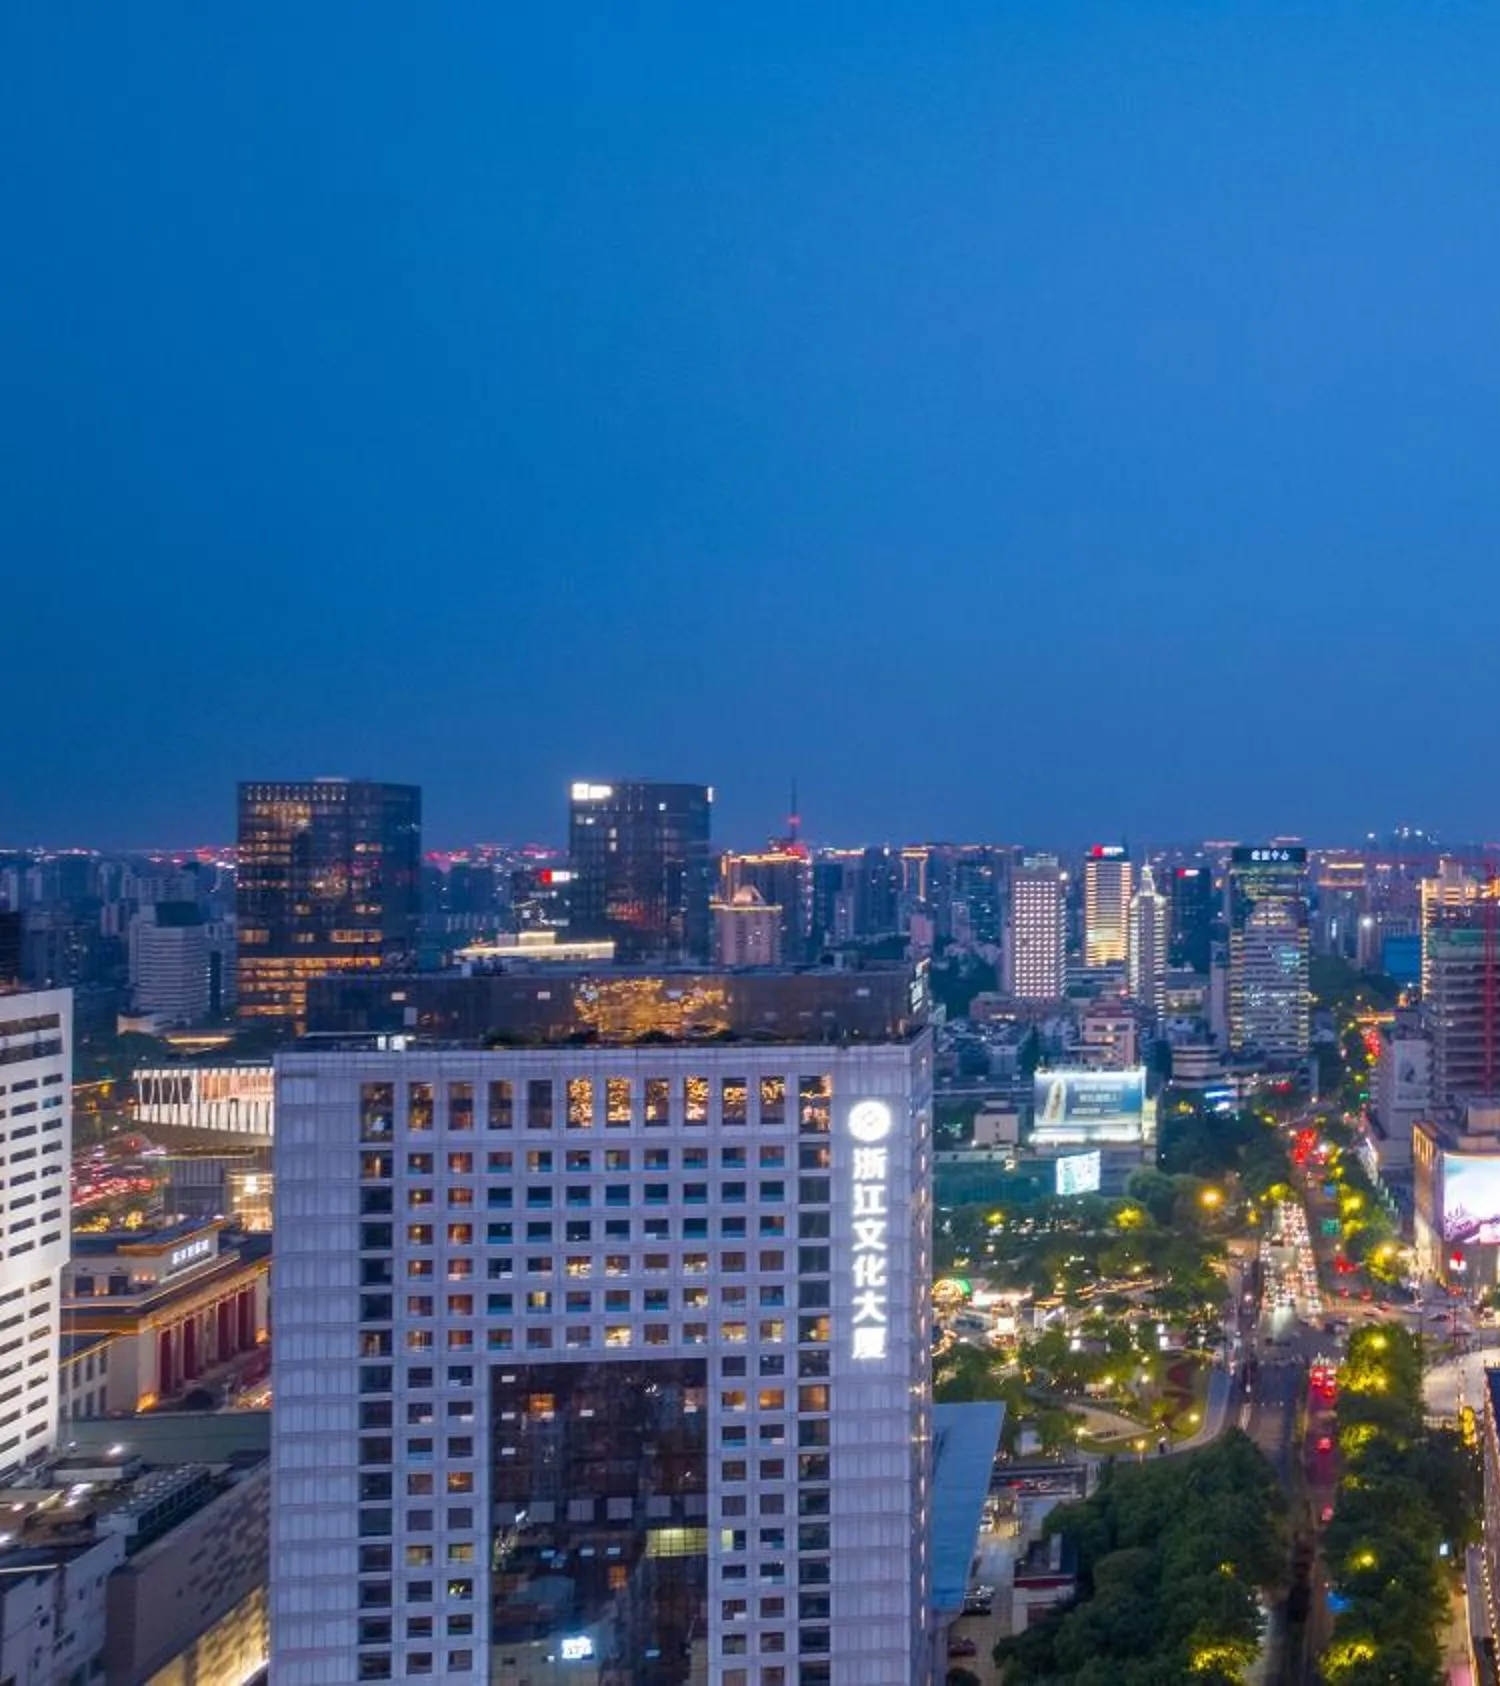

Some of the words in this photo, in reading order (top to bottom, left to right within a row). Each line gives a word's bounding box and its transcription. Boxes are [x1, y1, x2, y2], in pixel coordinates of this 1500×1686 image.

[852, 1147, 887, 1359] 浙江文化大厦
